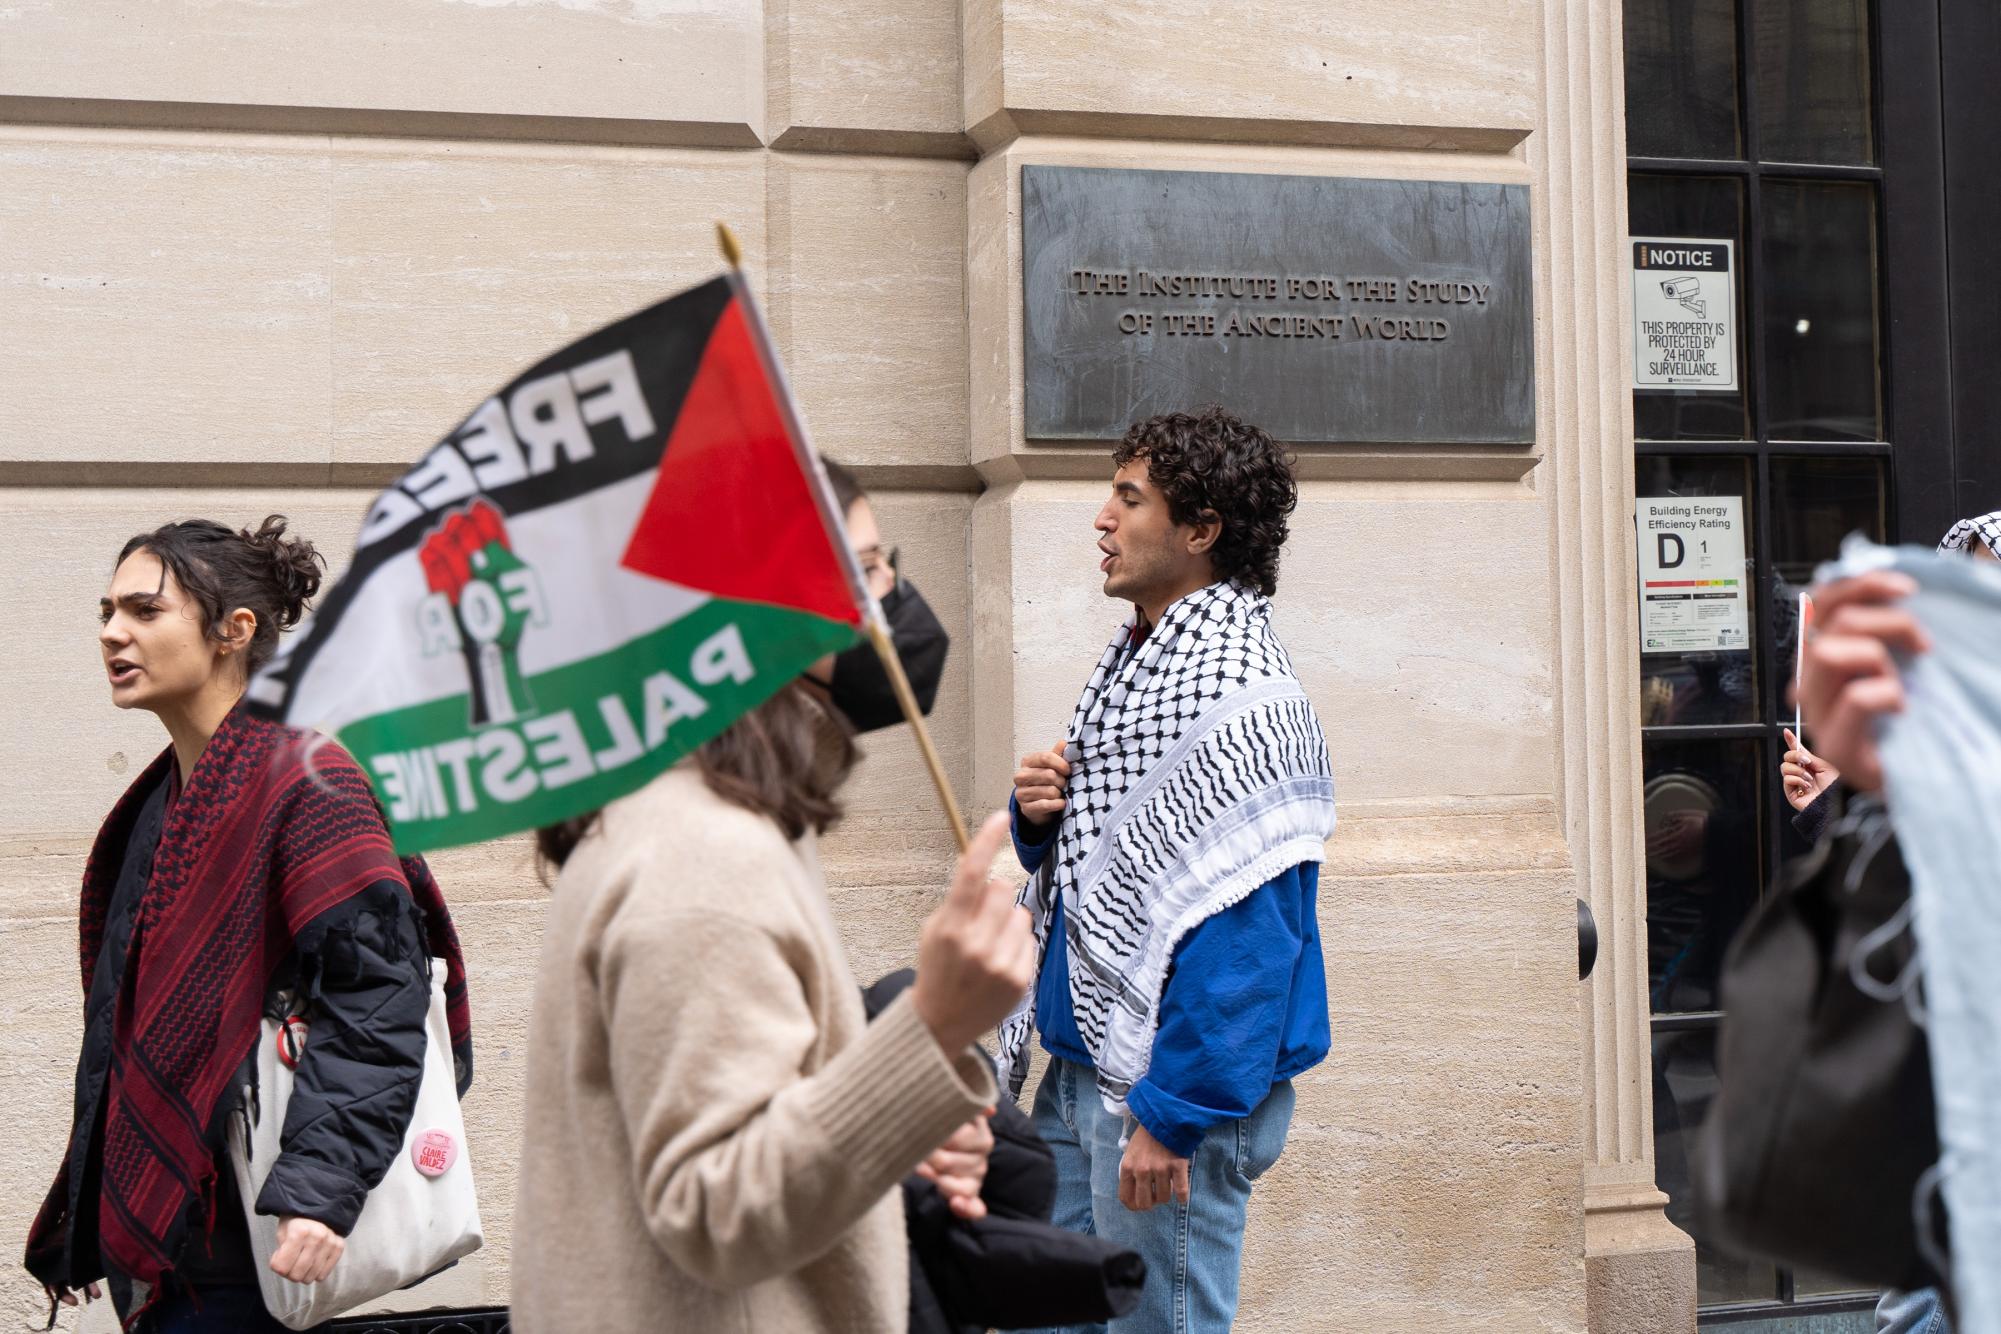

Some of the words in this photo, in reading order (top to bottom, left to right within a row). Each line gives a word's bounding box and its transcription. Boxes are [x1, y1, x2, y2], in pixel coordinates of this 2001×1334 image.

[1650, 249, 1713, 266] NOTICE
[1073, 271, 1129, 296] THE
[1138, 271, 1277, 299] INSTITUTE
[1286, 278, 1341, 300] FOR
[1346, 280, 1398, 303] THE
[1407, 279, 1490, 305] STUDY
[1118, 313, 1153, 335] OF
[1162, 315, 1215, 337] THE
[1223, 312, 1343, 339] ANCIENT
[1352, 316, 1449, 341] WORLD
[1641, 321, 1664, 335] THIS
[1666, 321, 1714, 335] PROPERTY
[1715, 322, 1725, 336] IS
[1648, 334, 1702, 349] PROTECTED
[1703, 335, 1716, 349] BY
[1663, 348, 1676, 362] 24
[1678, 349, 1705, 362] HOUR
[1649, 362, 1720, 376] SURVEILLANCE.
[1650, 506, 1691, 517] Building
[1693, 505, 1728, 516] Energy
[1648, 520, 1697, 531] Efficiency
[1699, 519, 1731, 530] Rating
[1657, 532, 1685, 569] D
[1700, 540, 1707, 553] 1
[422, 1146, 447, 1160] CLAIRE
